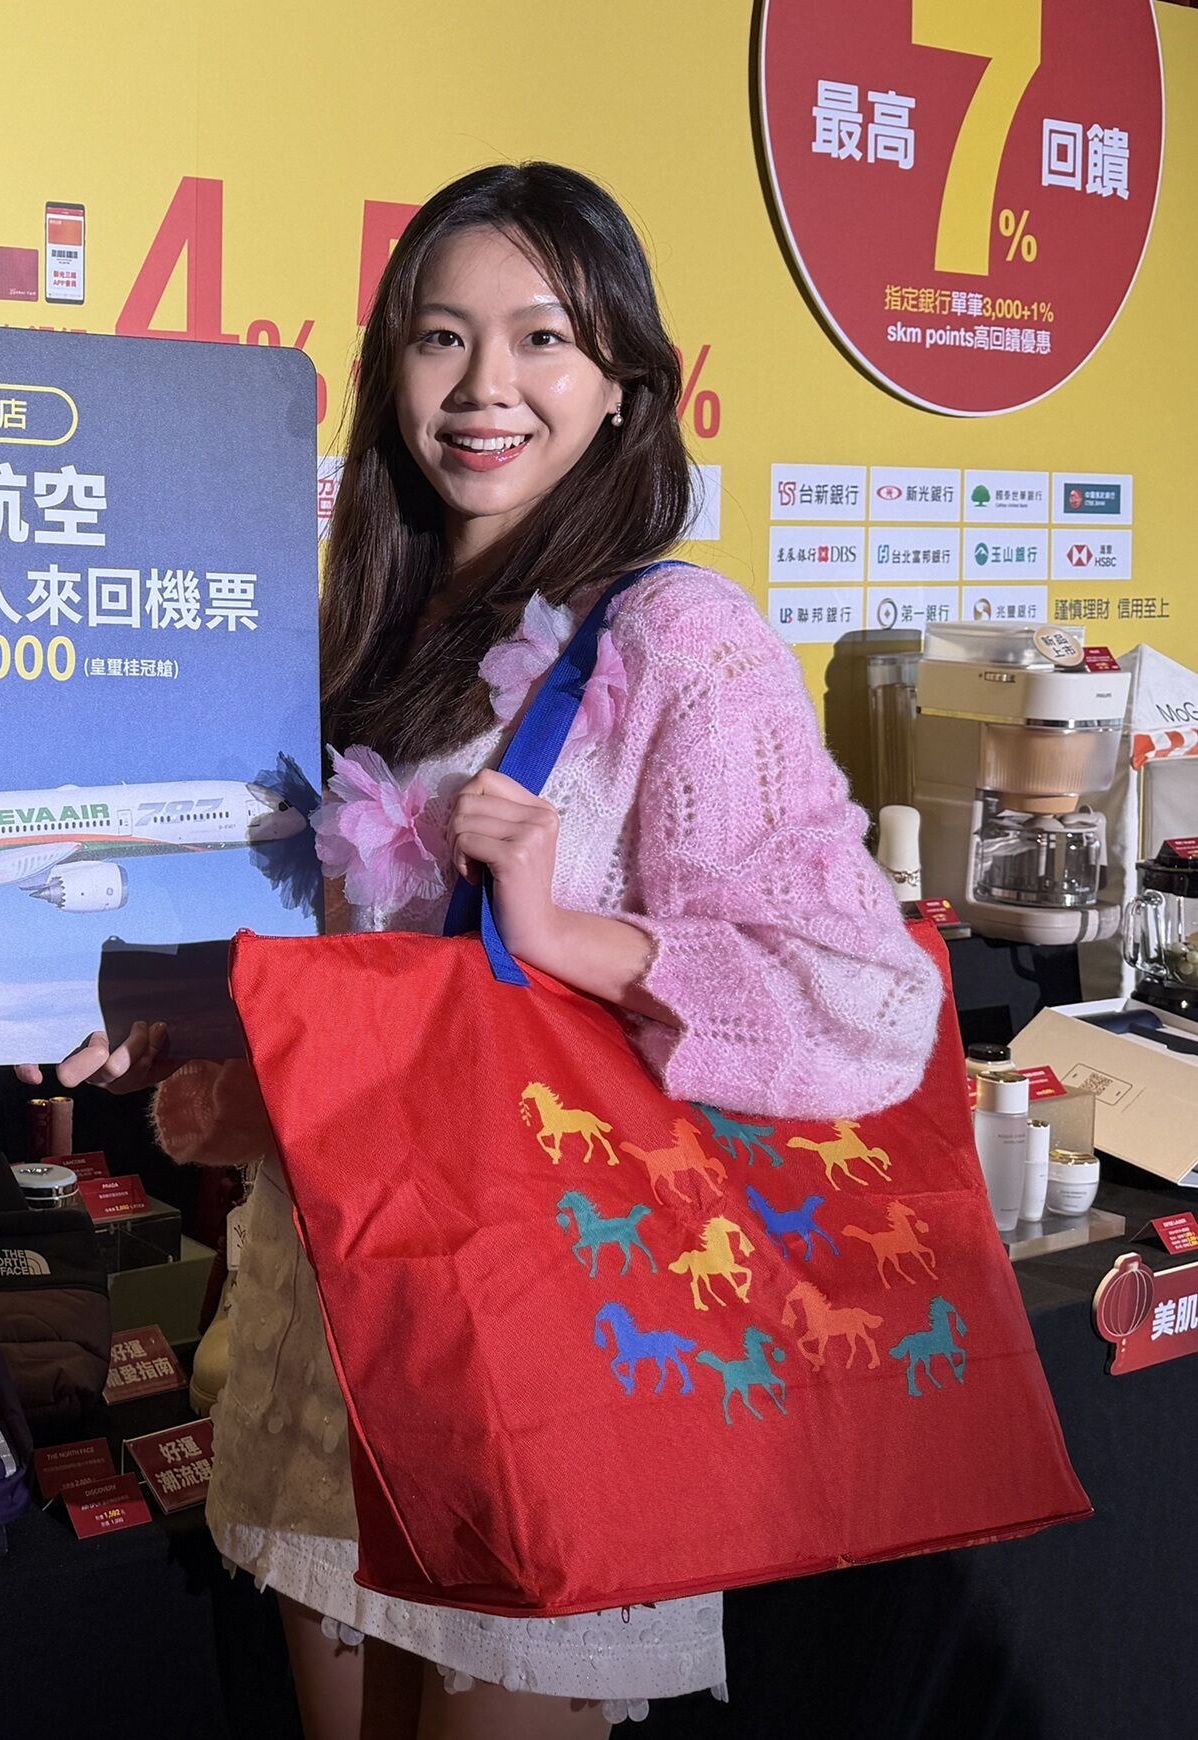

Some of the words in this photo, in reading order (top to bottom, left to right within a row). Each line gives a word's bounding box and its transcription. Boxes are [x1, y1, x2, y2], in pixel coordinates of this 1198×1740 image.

[812, 80, 915, 170] 最高
[1041, 118, 1130, 200] 回饋
[884, 285, 1055, 323] 指定銀行單筆3,000+1%
[887, 323, 922, 345] skm
[925, 325, 1052, 356] points高回饋優惠
[799, 483, 859, 506] 台新銀行
[905, 485, 954, 503] 新光銀行
[830, 545, 857, 563] DBS
[892, 549, 951, 564] 台北富邦銀行
[991, 546, 1038, 563] 玉山銀行
[1095, 557, 1117, 567] HSBC
[797, 606, 852, 624] 聯邦銀行
[901, 604, 950, 623] 第一銀行
[1054, 598, 1111, 621] 謹慎理財
[1117, 597, 1170, 620] 信用至上
[59, 802, 110, 822] AIR
[2, 1248, 25, 1258] THE
[0, 1266, 30, 1276] FACE
[1151, 1293, 1198, 1341] 美肌
[110, 1339, 148, 1363] 好運
[158, 1435, 203, 1464] 好運
[155, 1456, 215, 1494] 潮流選
